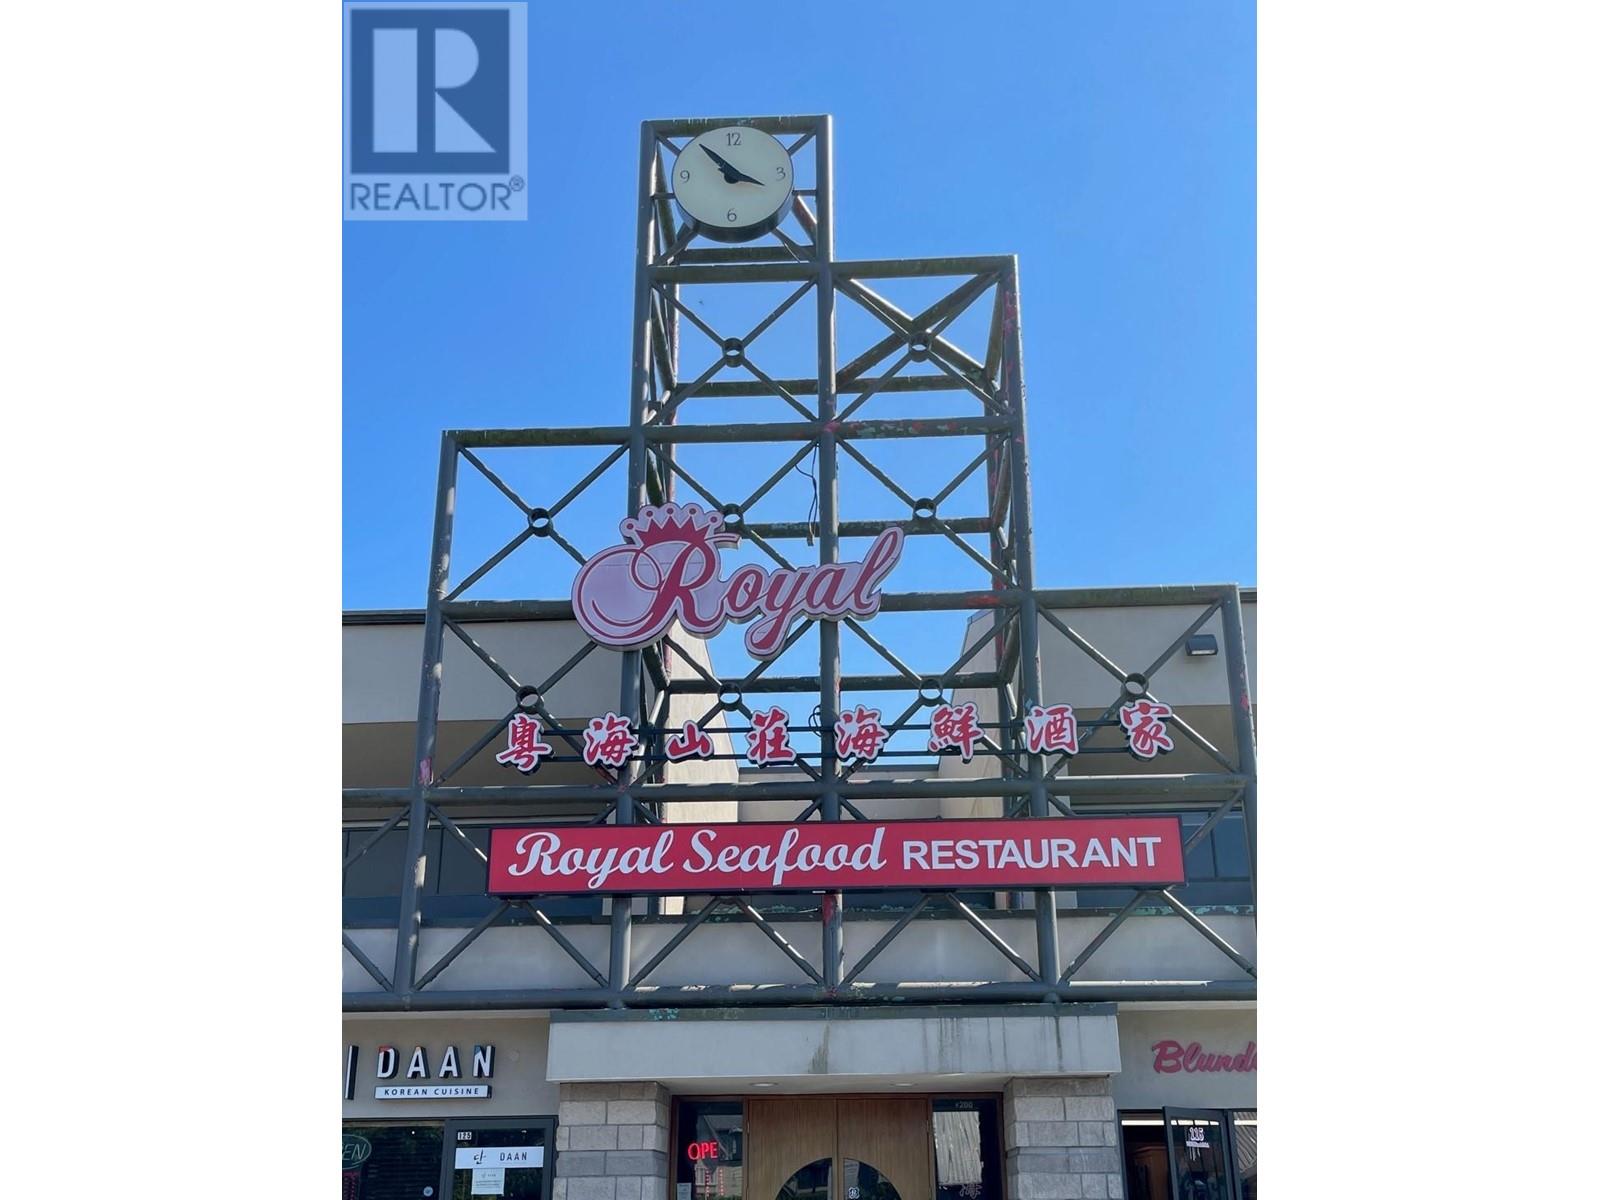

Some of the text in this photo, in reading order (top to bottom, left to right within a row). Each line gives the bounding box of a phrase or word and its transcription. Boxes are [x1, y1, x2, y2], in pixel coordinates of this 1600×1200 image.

[725, 132, 742, 146] 12
[679, 170, 690, 184] 9
[775, 166, 786, 181] 3
[726, 207, 737, 222] 6
[577, 528, 901, 648] Royal
[508, 827, 1162, 889] Royal Seafood RESTAURANT
[376, 1045, 495, 1079] DAAN
[384, 1087, 480, 1096] KOREAN CUISINE
[342, 1143, 367, 1161] EN
[500, 1151, 528, 1161] DAAN
